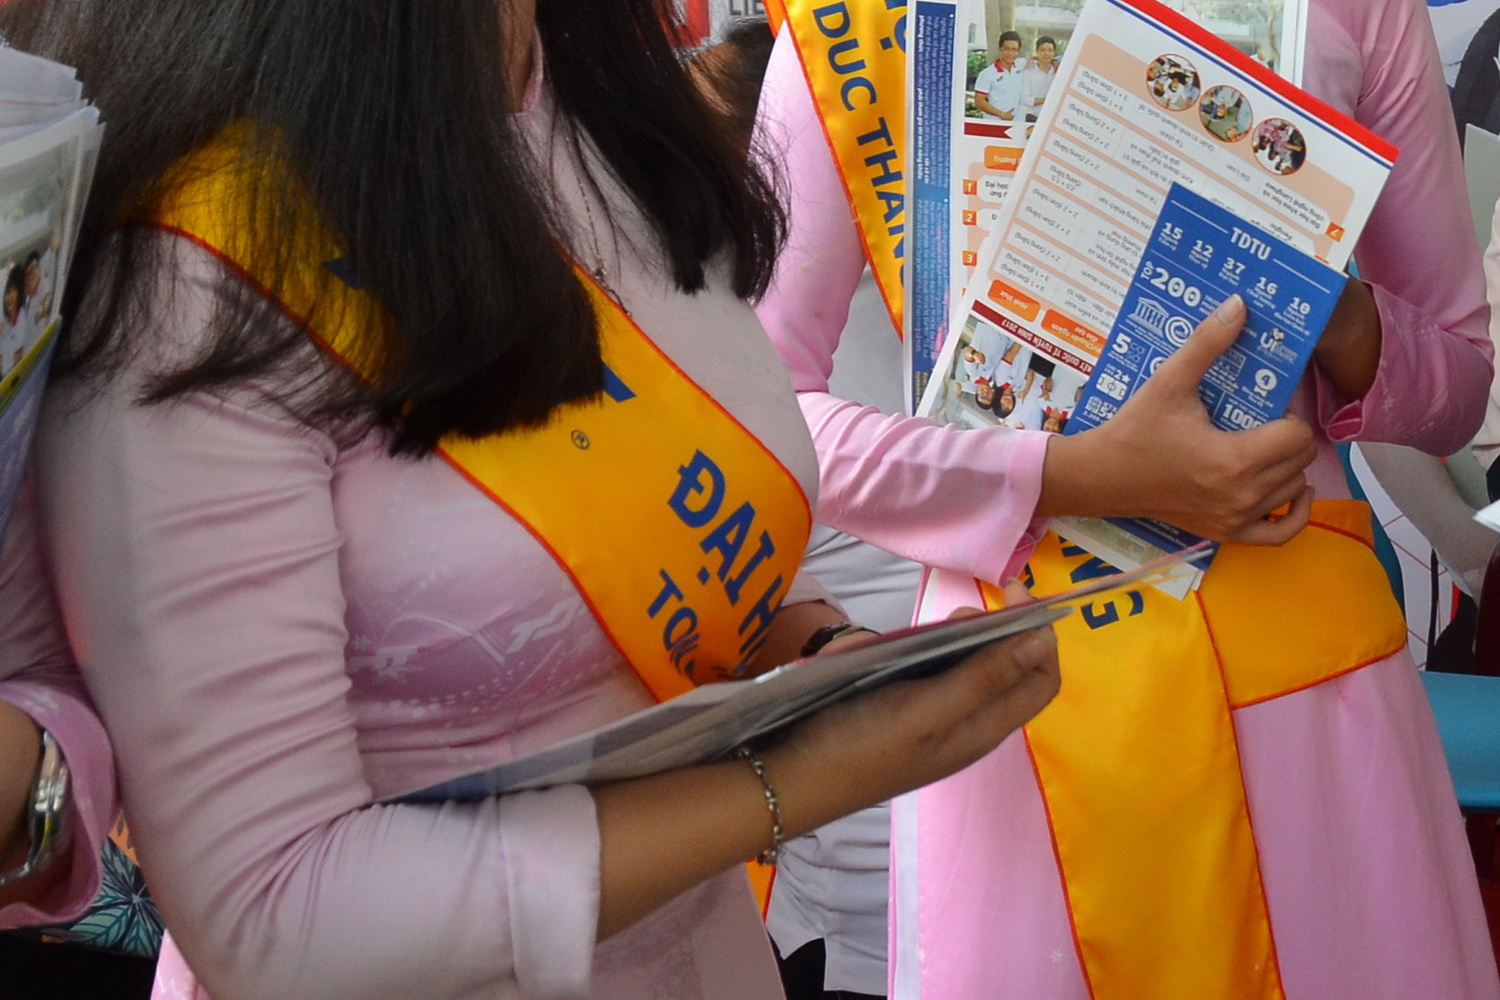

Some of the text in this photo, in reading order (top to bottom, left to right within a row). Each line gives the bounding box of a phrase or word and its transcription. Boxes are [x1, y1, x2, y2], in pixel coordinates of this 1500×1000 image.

[813, 1, 877, 112] DUC
[1162, 222, 1183, 240] 15
[1192, 240, 1213, 258] 12
[1223, 257, 1245, 275] 37
[1256, 276, 1277, 295] 16
[1230, 227, 1271, 260] TDTU
[1149, 267, 1201, 307] 200
[1000, 318, 1018, 332] 2017
[1112, 333, 1132, 354] 5
[667, 449, 776, 606] ĐẠI
